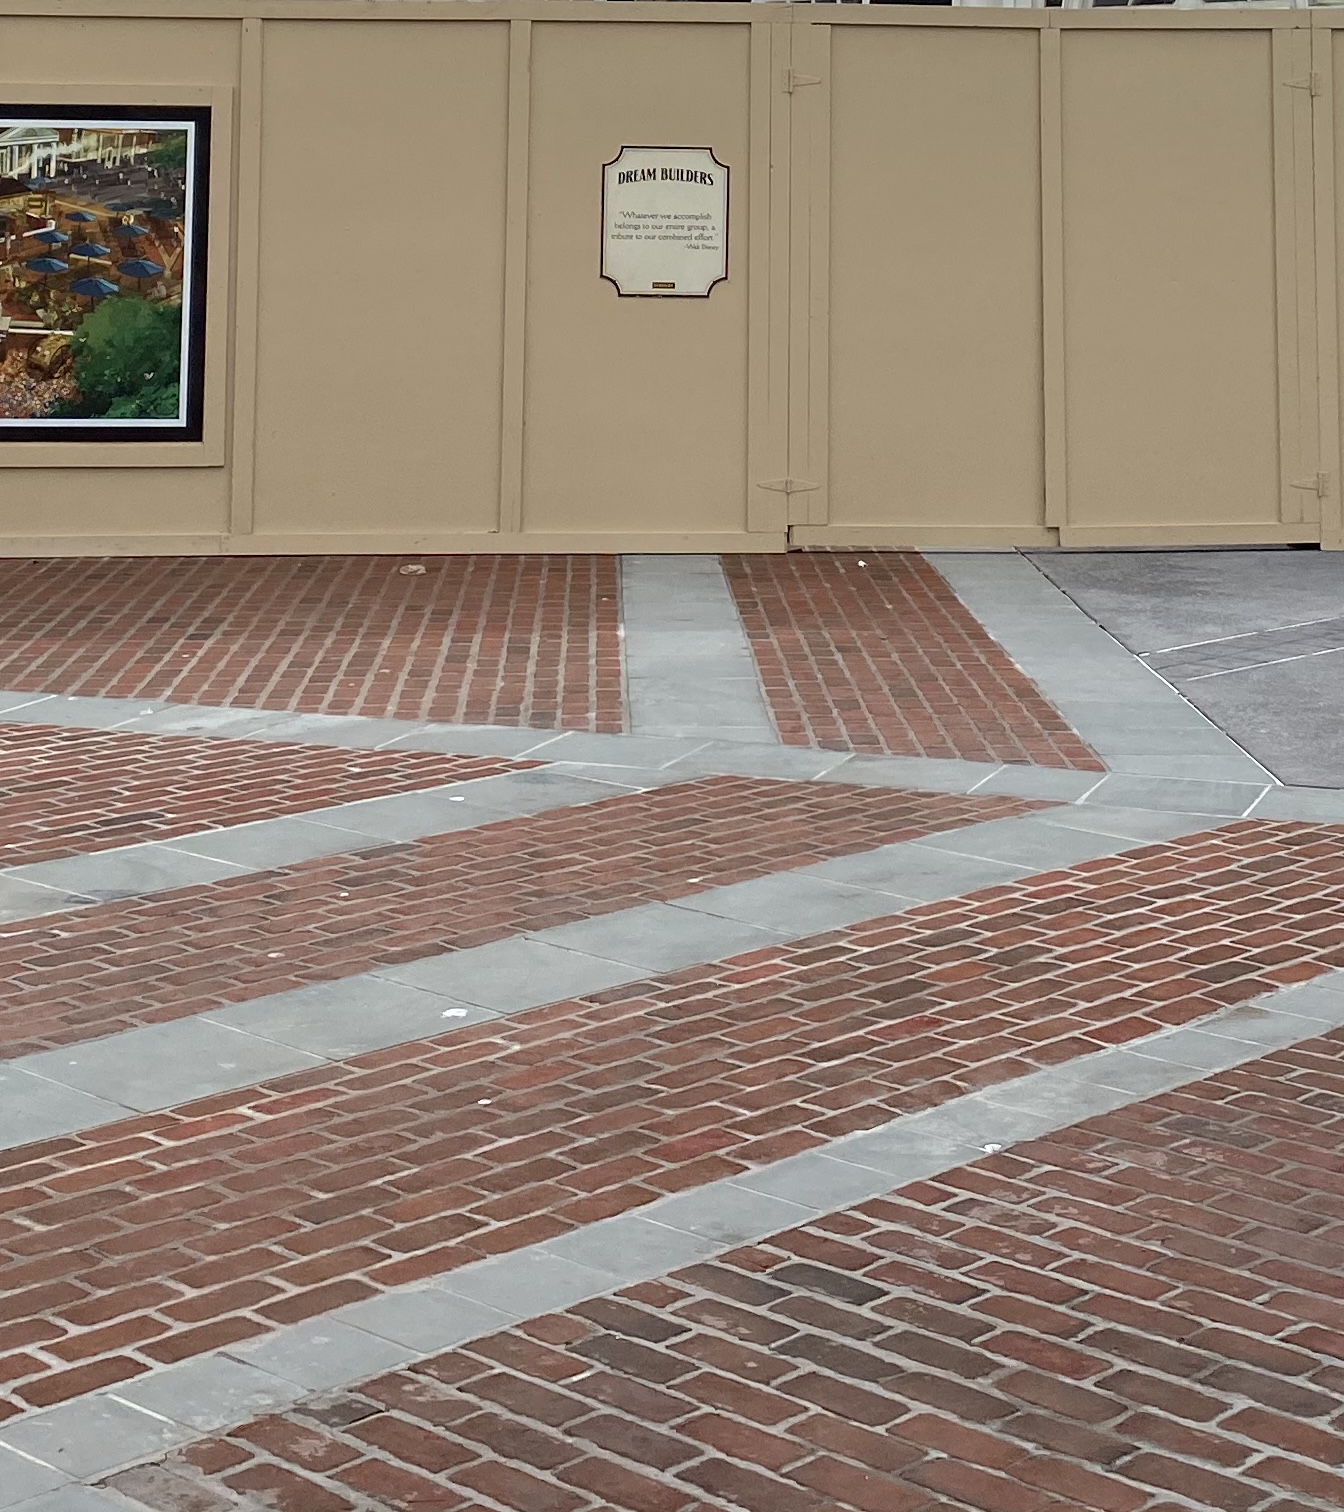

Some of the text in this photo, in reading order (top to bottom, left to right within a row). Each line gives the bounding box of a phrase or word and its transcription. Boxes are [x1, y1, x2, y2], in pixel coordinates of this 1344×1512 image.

[618, 167, 714, 186] DREAM BUILDERS
[673, 212, 712, 221] accomplish
[614, 222, 641, 230] belongs
[611, 232, 633, 240] tribute
[658, 233, 692, 241] combined
